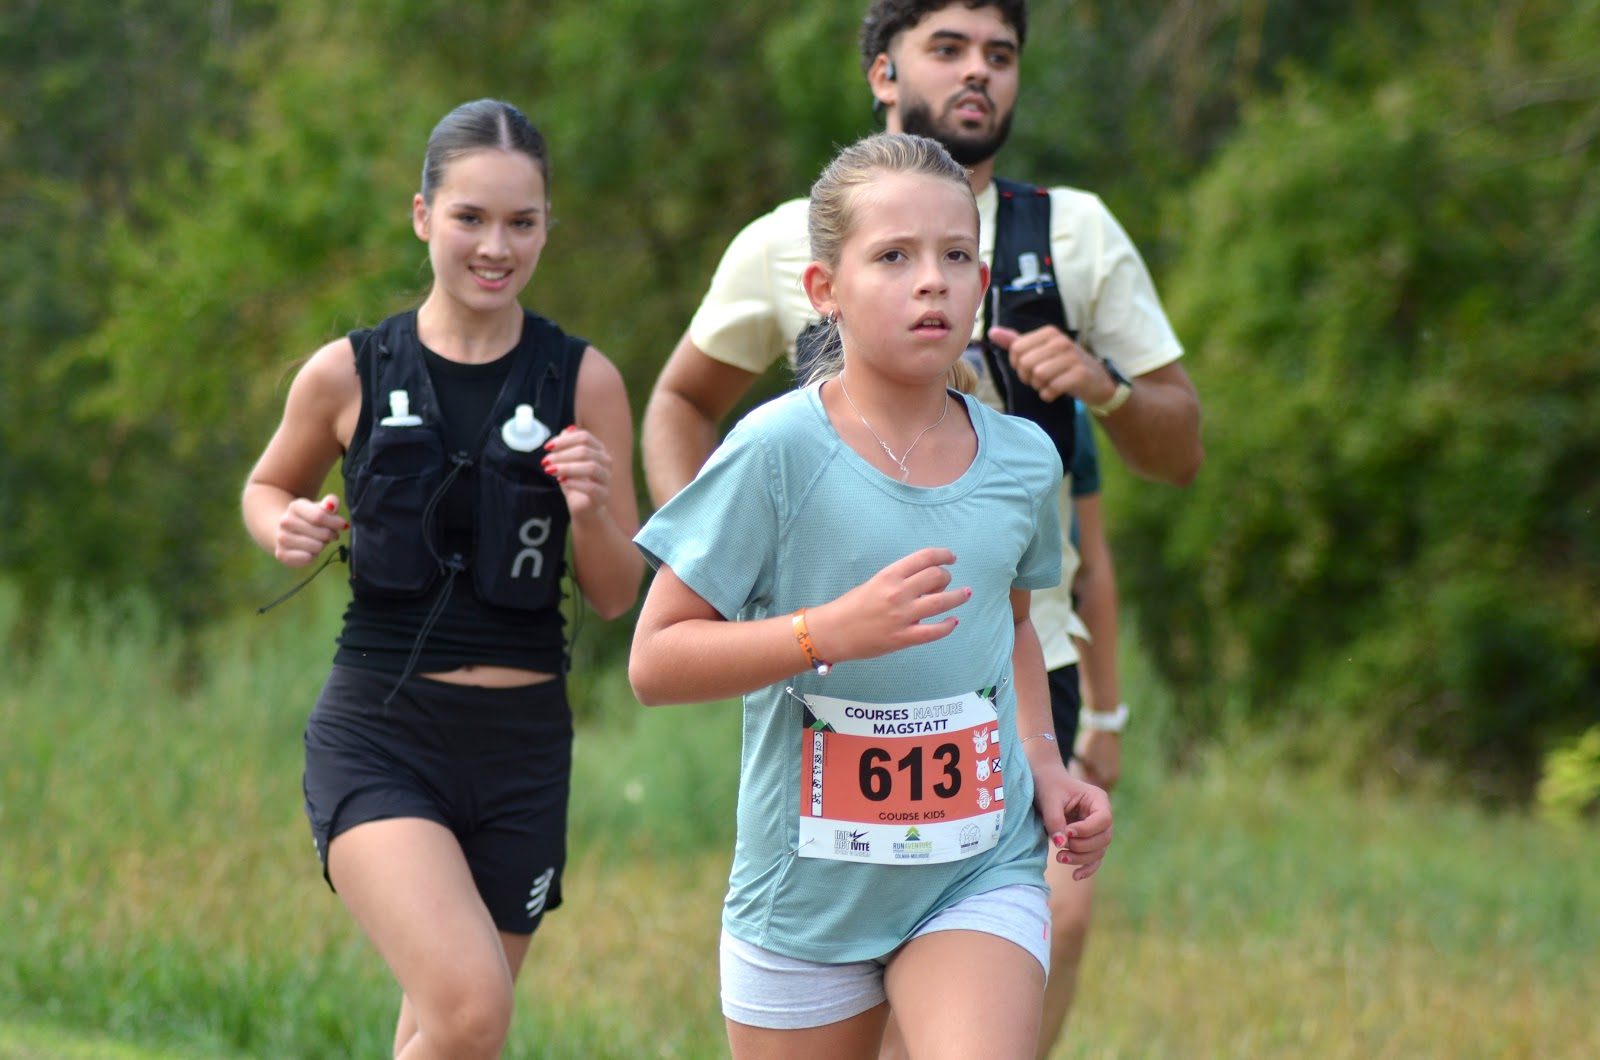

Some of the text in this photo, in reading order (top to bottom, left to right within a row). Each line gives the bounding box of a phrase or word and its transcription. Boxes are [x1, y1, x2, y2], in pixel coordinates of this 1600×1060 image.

[845, 702, 963, 720] COURSES NATURE
[873, 719, 948, 734] MAGSTATT
[858, 743, 962, 801] 613
[878, 810, 945, 820] COURSE KIDS
